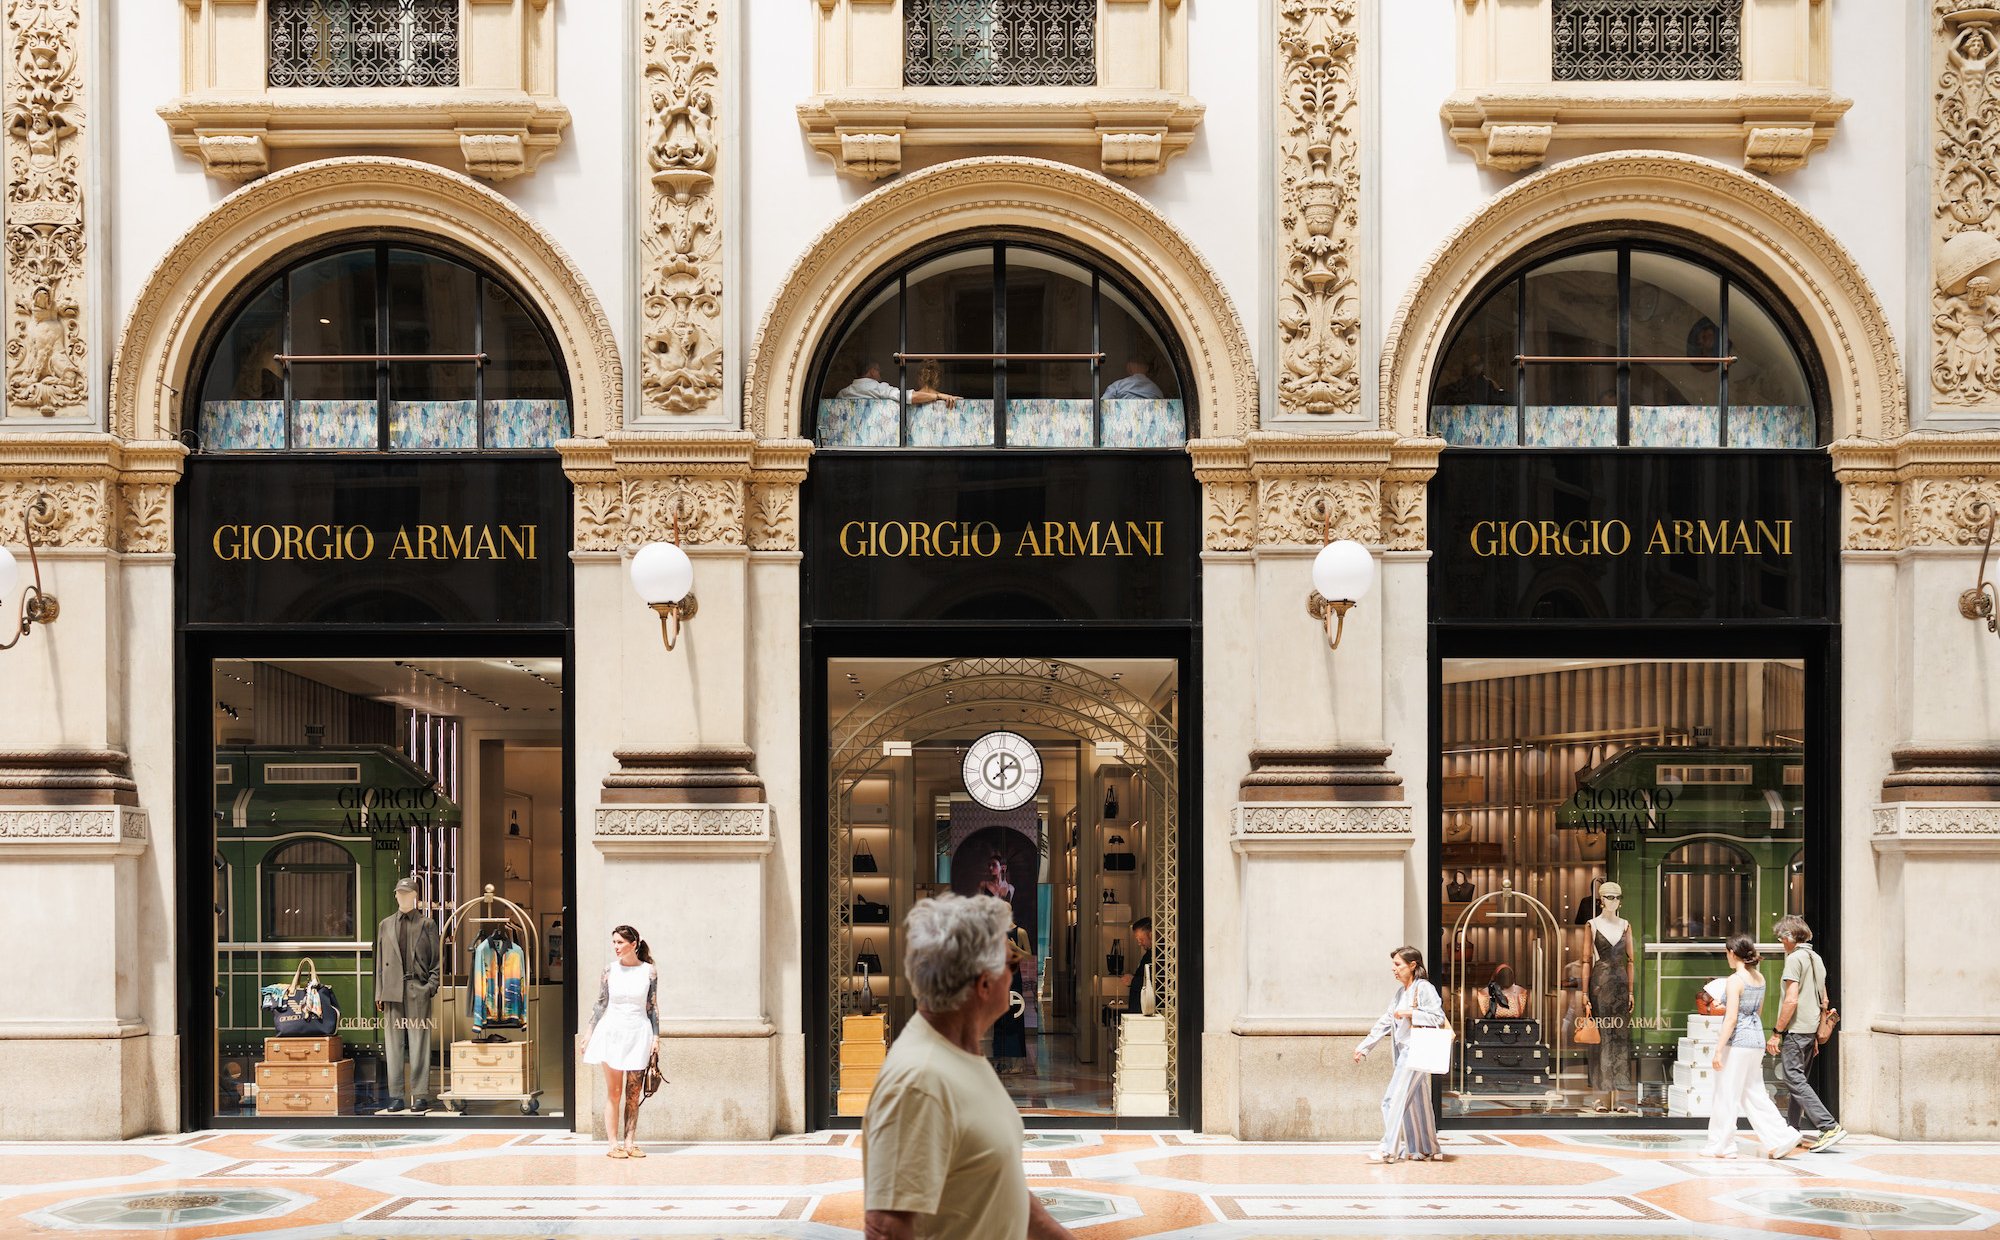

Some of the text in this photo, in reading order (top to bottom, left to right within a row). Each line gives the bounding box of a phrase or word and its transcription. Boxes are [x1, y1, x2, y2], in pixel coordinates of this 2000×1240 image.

[213, 524, 537, 561] GIORGIO ARMANI
[839, 520, 1164, 557] GIORGIO ARMANI
[1470, 519, 1792, 556] GIORGIO ARMANI
[338, 787, 438, 809] GIORGIO
[1573, 788, 1673, 810] GIORGIO
[340, 812, 432, 834] ARMANI
[1577, 812, 1667, 834] ARMANI
[376, 841, 399, 849] KITH
[1612, 841, 1635, 850] KITH
[340, 1017, 438, 1030] GIORGIO ARMANI
[1574, 1016, 1672, 1029] GIORGIO ARMANI
